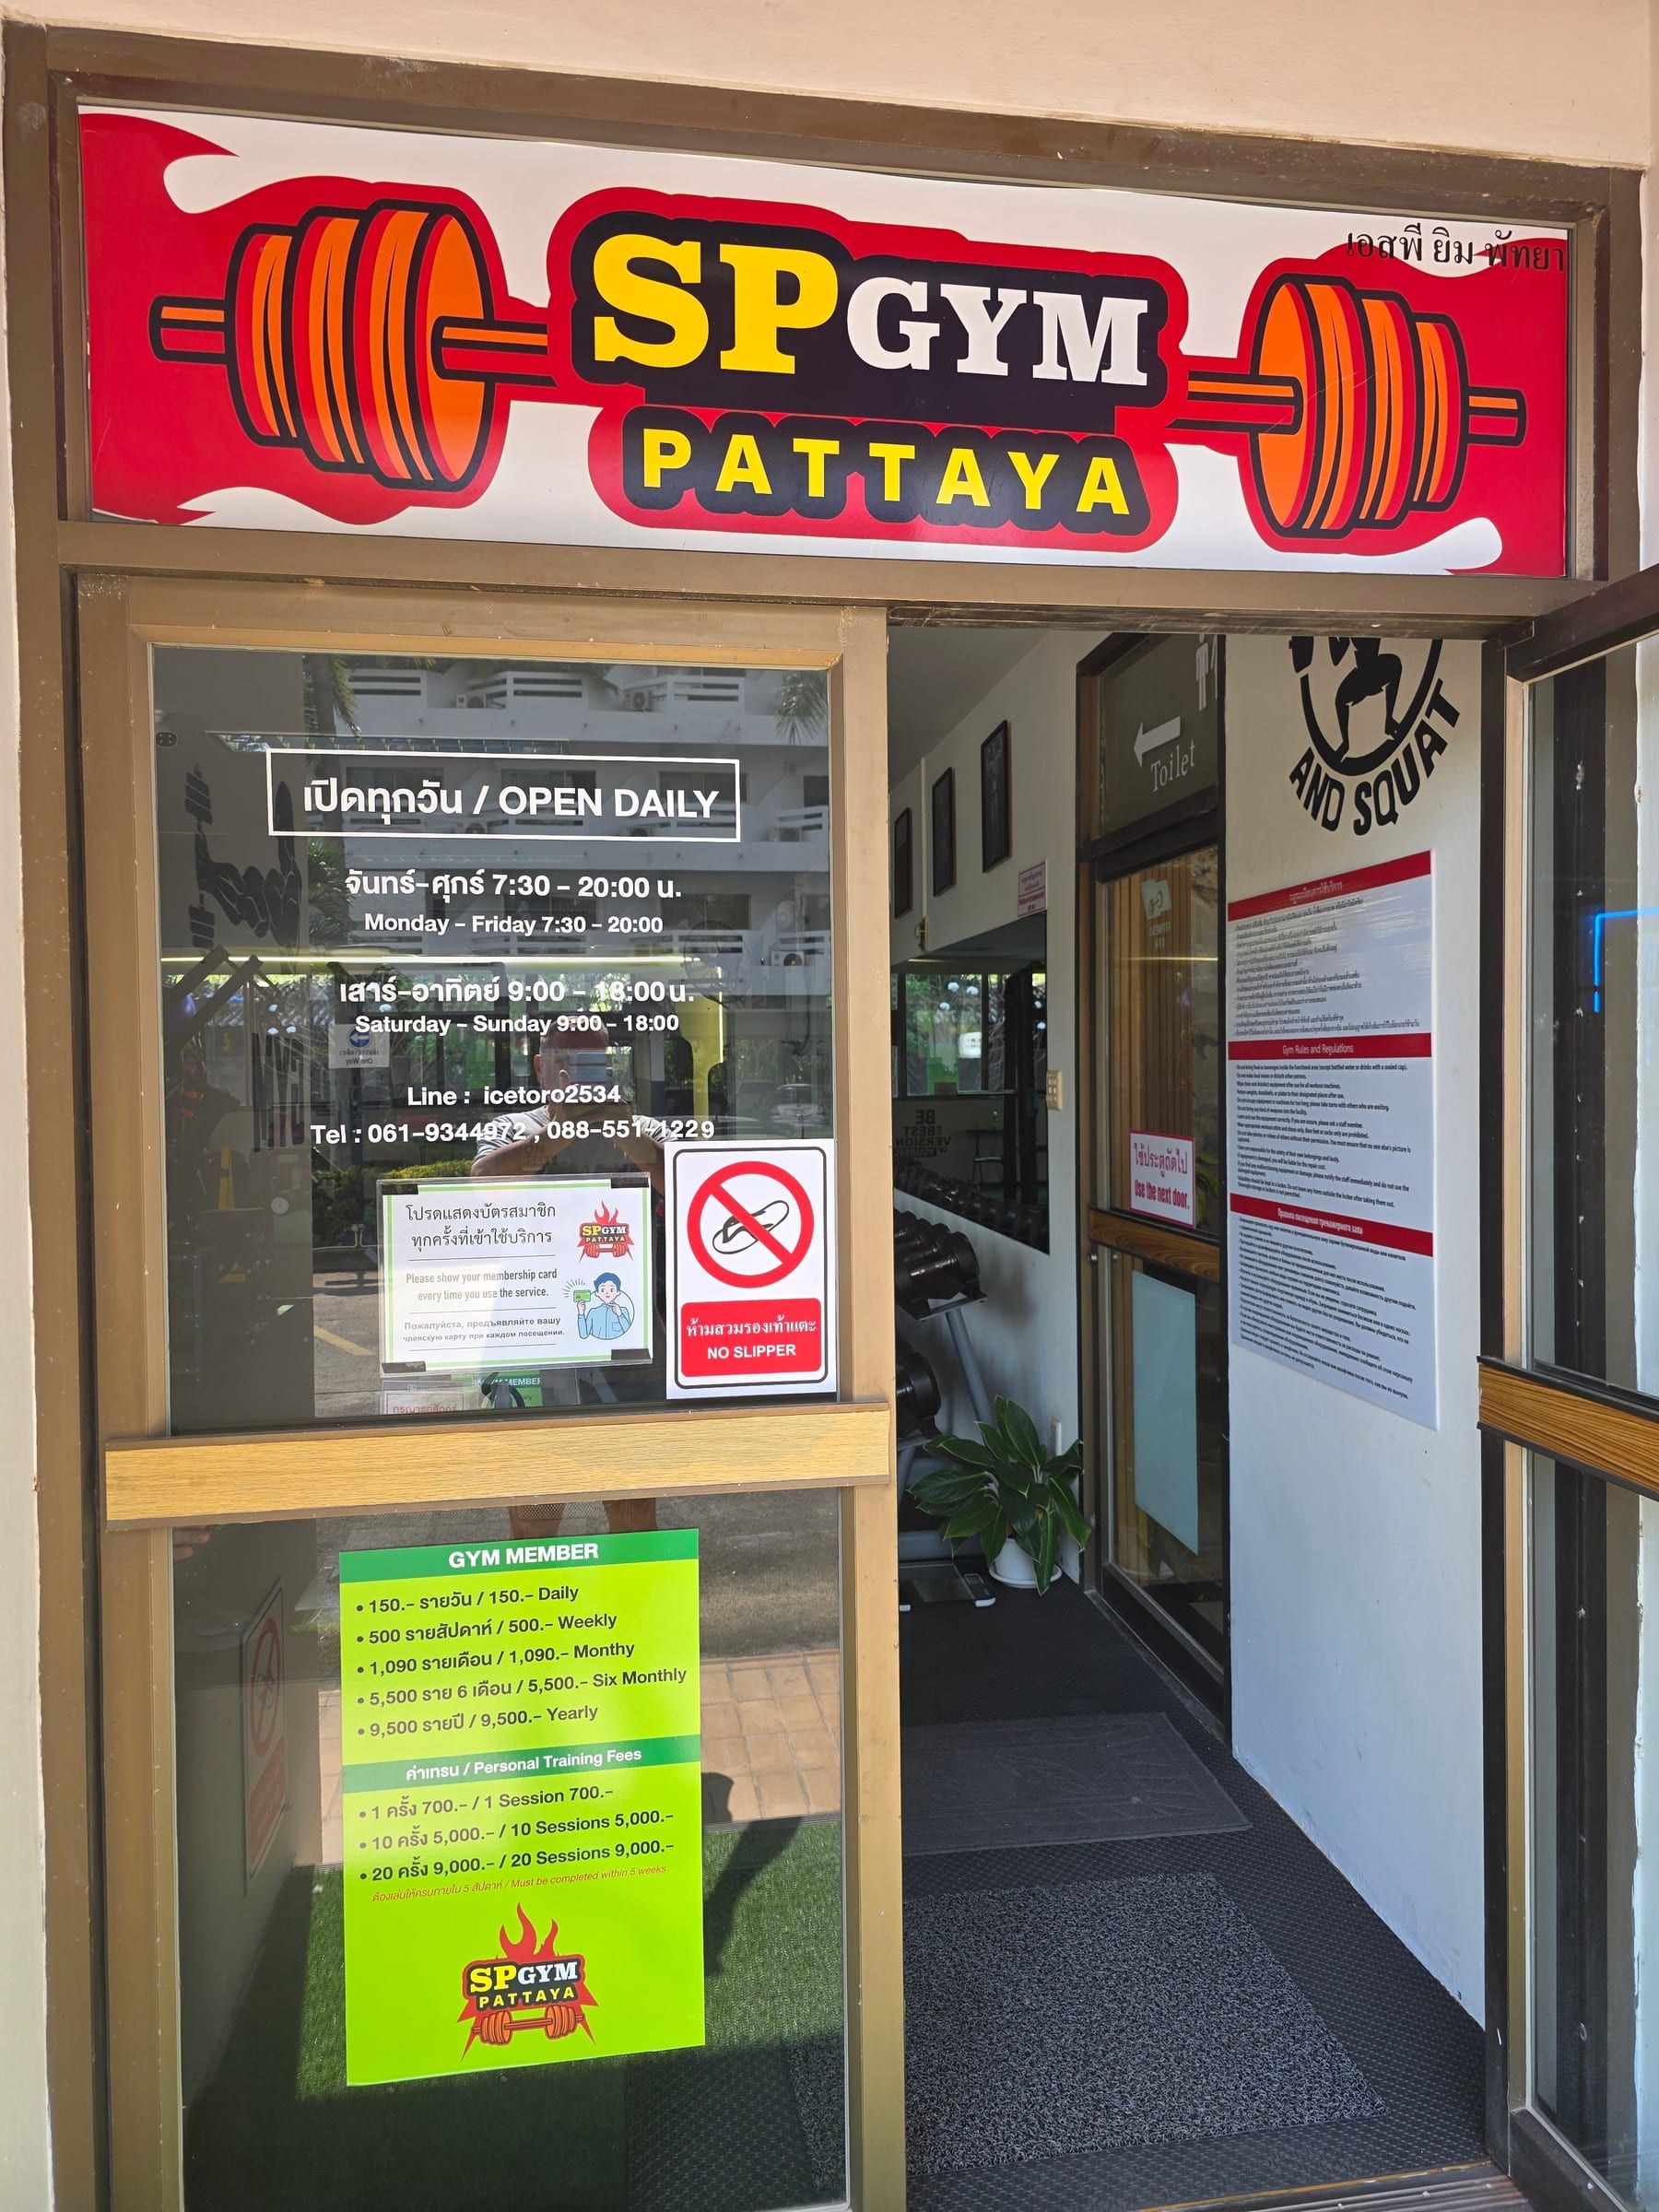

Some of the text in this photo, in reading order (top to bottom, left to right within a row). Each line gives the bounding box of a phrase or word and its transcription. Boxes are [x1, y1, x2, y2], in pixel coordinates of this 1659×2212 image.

[1347, 223, 1564, 271] เอสพี ยิม พัทยา
[643, 429, 1130, 516] PATTAYA
[1150, 738, 1196, 793] Toilet
[1289, 678, 1460, 835] AND SQUAT
[304, 778, 719, 824] เปิดทุกวัน / OPEN DAILY
[493, 875, 549, 896] 7:30
[579, 877, 649, 898] 20:00
[658, 881, 680, 898] น.
[365, 913, 449, 935] Monday
[473, 916, 536, 936] Friday
[542, 917, 585, 933] 7:30
[608, 916, 663, 933] 20:00
[508, 981, 565, 1001] 9:00
[595, 981, 665, 1001] 18:00
[670, 985, 693, 1001] น.
[356, 1016, 451, 1036] Saturday
[474, 1016, 551, 1035] Sunday
[557, 1016, 601, 1030] 9:00
[624, 1015, 678, 1030] 18:00
[1283, 1043, 1353, 1056] Gym Rules and Regulations
[408, 1088, 456, 1105] Line
[485, 1084, 620, 1104] icetoro2534
[311, 1125, 346, 1143] Tel
[1135, 1180, 1190, 1209] Use the next door.
[406, 1202, 555, 1220] โปรดแสดงบัตรสมาชิก
[411, 1225, 552, 1253] ทุกครั้งที่เข้าใช้บริการ
[406, 1268, 557, 1285] Please show your membership card
[418, 1292, 441, 1303] every
[444, 1290, 463, 1300] time
[465, 1291, 479, 1301] you
[500, 1287, 512, 1298] the
[515, 1287, 548, 1297] service.
[405, 1321, 464, 1331] Пожалуйста,
[467, 1317, 535, 1329] предъявляйте
[687, 1315, 816, 1336] ห้ามสวมรองเท้าแตะ
[708, 1344, 796, 1359] NO SLIPPER
[449, 1543, 598, 1568] GYM MEMBER
[420, 1592, 472, 1609] รายวัน
[477, 1592, 485, 1606] /
[539, 1585, 579, 1602] Daily
[369, 1630, 400, 1643] 500
[406, 1618, 492, 1641] รายสัปดาห์
[496, 1620, 504, 1634] /
[558, 1613, 618, 1630] Weekly
[370, 1659, 417, 1677] 1,090
[422, 1652, 492, 1670] รายเดือน
[497, 1651, 504, 1665] /
[574, 1642, 634, 1658] Monthy
[371, 1689, 417, 1707] 5,500
[422, 1688, 452, 1701] ราย
[457, 1685, 467, 1698] 6
[473, 1680, 511, 1697] เดือน
[516, 1679, 524, 1694] /
[594, 1674, 618, 1687] Six
[623, 1668, 687, 1685] Monthly
[371, 1720, 417, 1738] 9,500
[423, 1712, 464, 1732] รายปี
[469, 1714, 477, 1728] /
[547, 1705, 598, 1721] Yearly
[406, 1749, 641, 1781] ค่าเทรน / Personal Training Fees
[372, 1806, 379, 1819] 1
[387, 1795, 417, 1818] ครั้ง
[472, 1796, 479, 1810] /
[485, 1795, 491, 1808] 1
[500, 1791, 564, 1806] Session
[372, 1836, 393, 1850] 10
[398, 1825, 428, 1847] ครั้ง
[499, 1824, 506, 1838] /
[512, 1823, 531, 1836] 10
[536, 1818, 610, 1834] Sessions
[372, 1867, 393, 1881] 20
[398, 1856, 428, 1878] ครั้ง
[500, 1854, 507, 1869] /
[511, 1853, 531, 1867] 20
[536, 1848, 610, 1865] Sessions
[464, 1884, 469, 1893] 5
[511, 1878, 534, 1888] Must
[536, 1877, 548, 1886] be
[550, 1871, 599, 1884] completed
[601, 1869, 627, 1878] within
[630, 1867, 635, 1876] 5
[638, 1865, 666, 1875] weeks
[479, 1987, 575, 2009] PATTAYA
